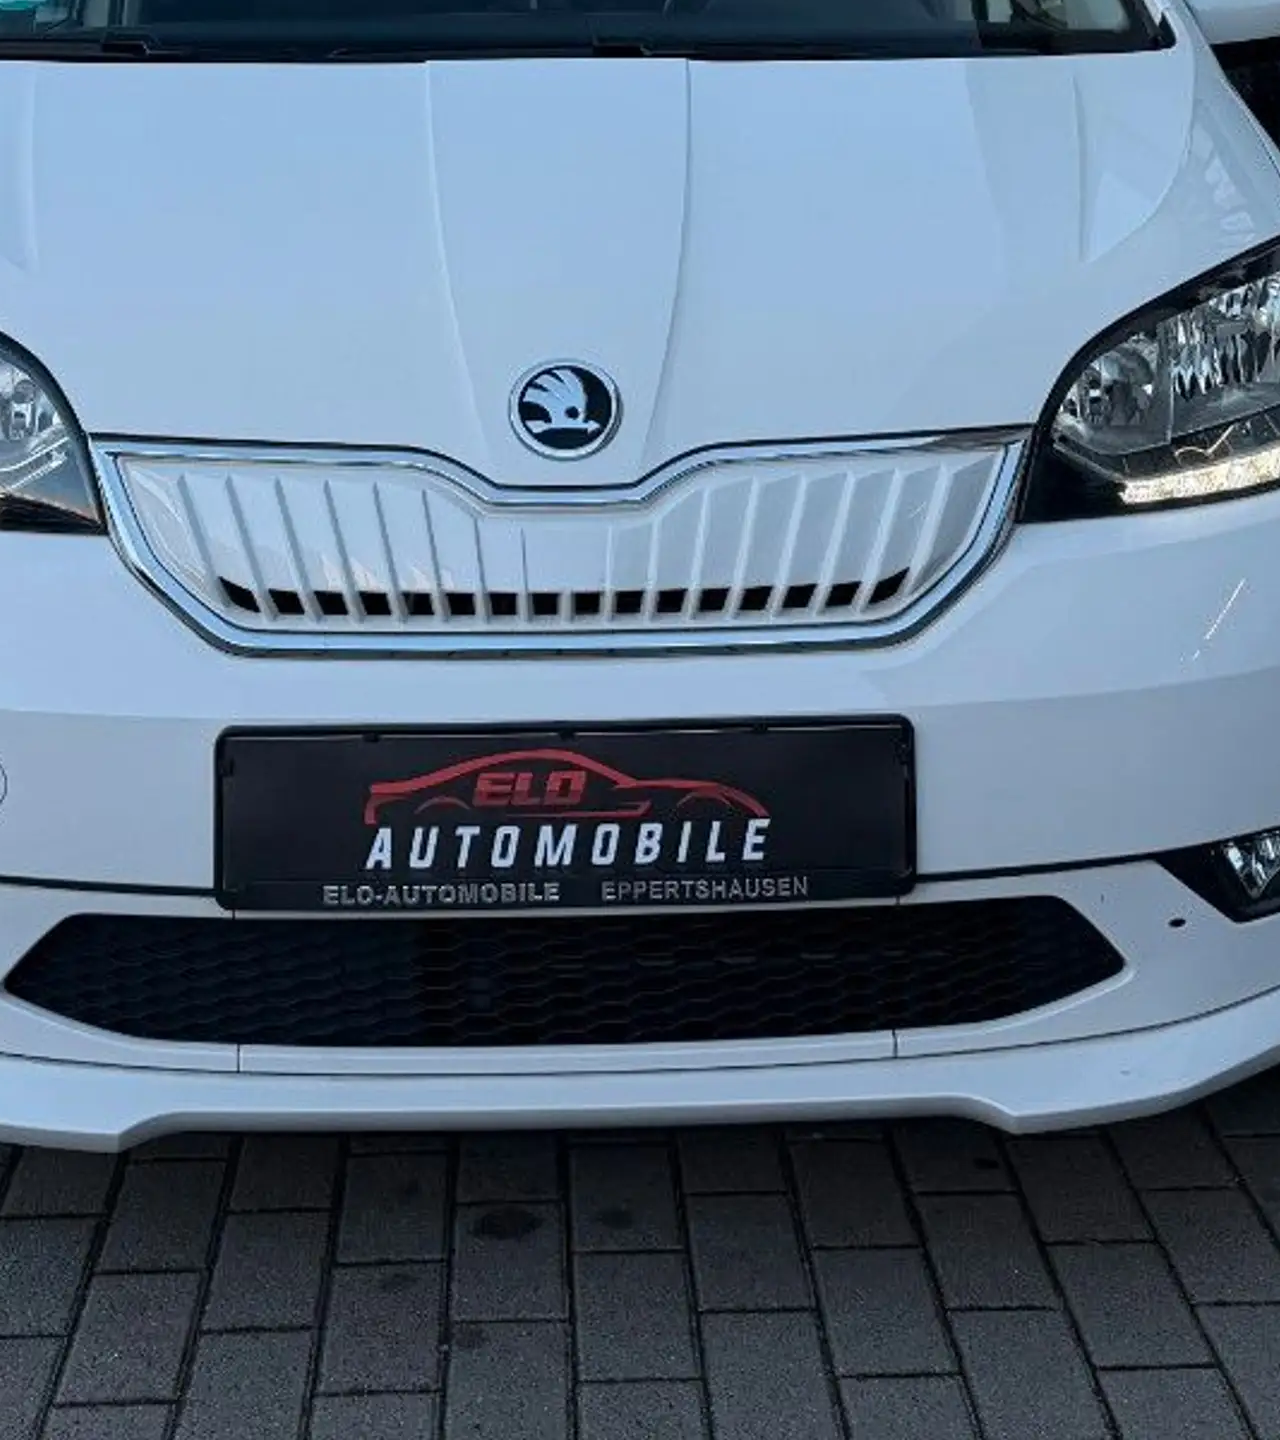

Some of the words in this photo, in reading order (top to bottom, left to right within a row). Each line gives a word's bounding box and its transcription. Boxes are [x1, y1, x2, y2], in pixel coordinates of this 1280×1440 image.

[472, 770, 587, 807] ELO
[365, 818, 771, 870] AUTOMOBILE
[322, 882, 560, 905] ELO-AUTOMOBILE
[601, 875, 809, 902] EPPERTSHAUSEN
